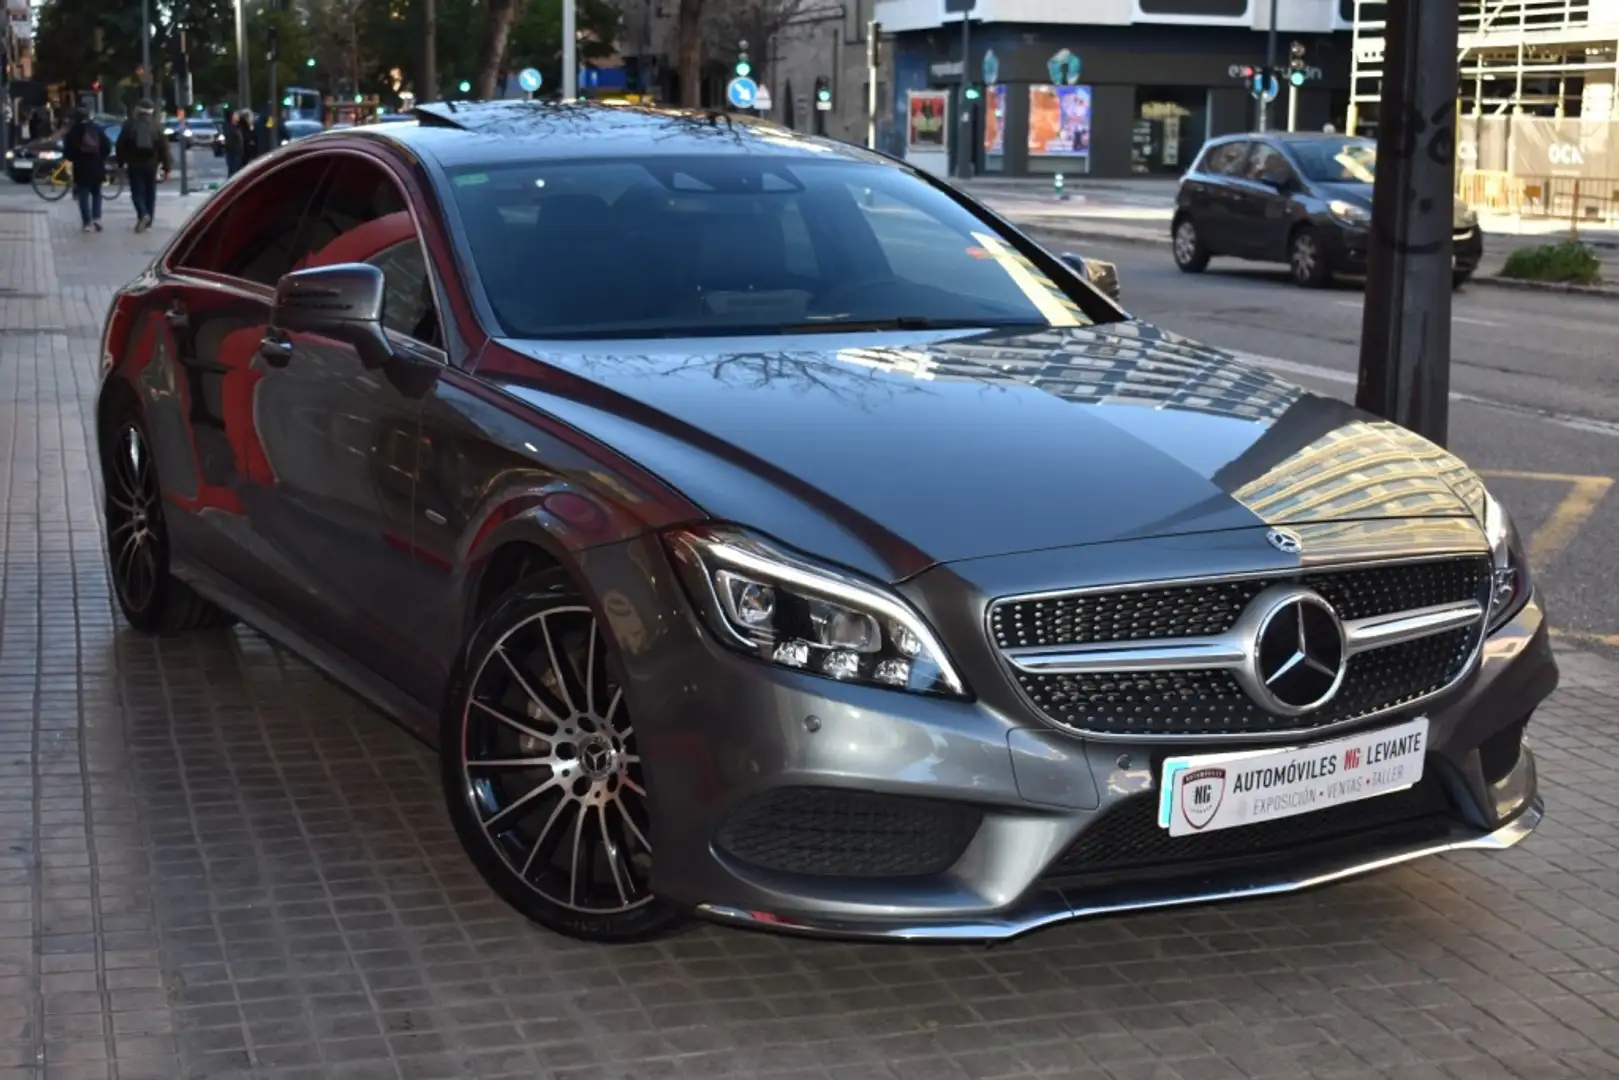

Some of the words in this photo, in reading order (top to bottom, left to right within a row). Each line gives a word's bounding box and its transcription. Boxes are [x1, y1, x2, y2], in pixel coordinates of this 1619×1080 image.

[1233, 755, 1337, 794] AUTOMÓVILES
[1344, 748, 1361, 771] NG
[1366, 732, 1422, 765] LEVANTE
[1194, 784, 1212, 805] NG
[1253, 787, 1317, 815] EXPOSICIÓN
[1327, 776, 1363, 799] VENTAS
[1373, 764, 1404, 786] TALLER
